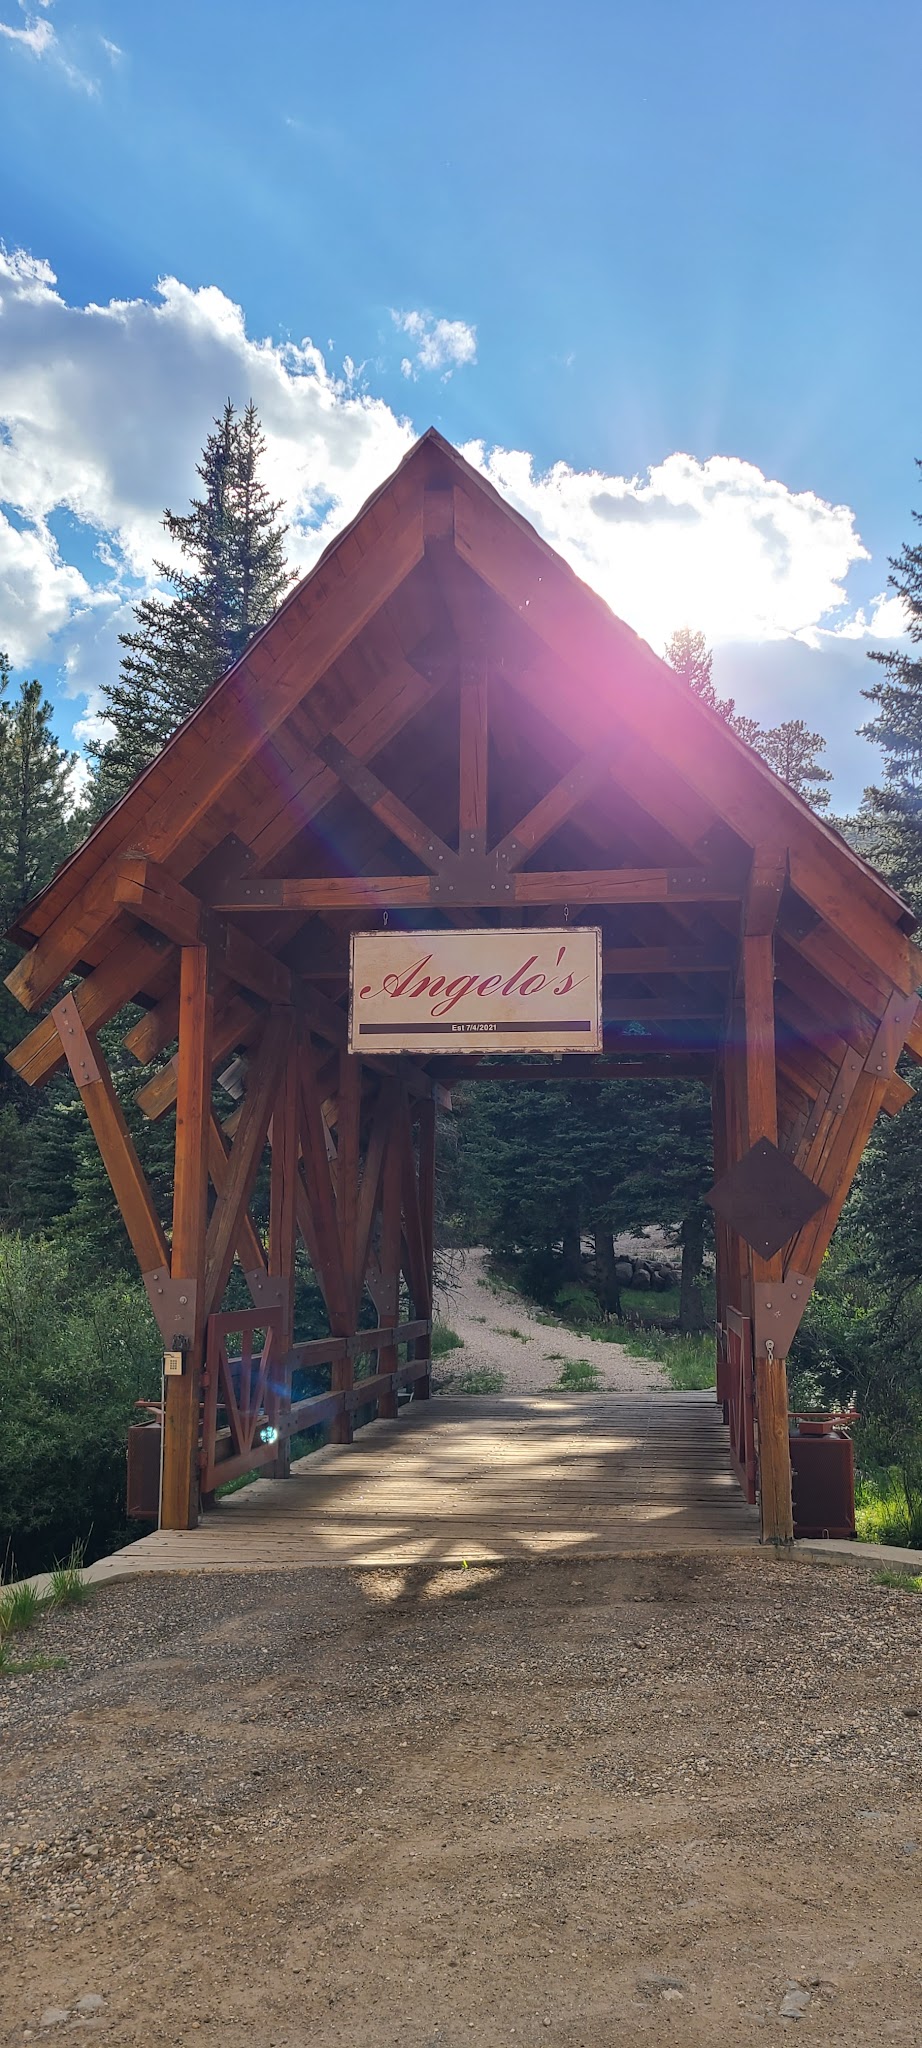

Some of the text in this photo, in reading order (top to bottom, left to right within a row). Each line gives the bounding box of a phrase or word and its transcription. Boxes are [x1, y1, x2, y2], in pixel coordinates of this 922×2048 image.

[359, 946, 589, 1017] Angelo's
[451, 1023, 498, 1032] Est 7/4/2021
